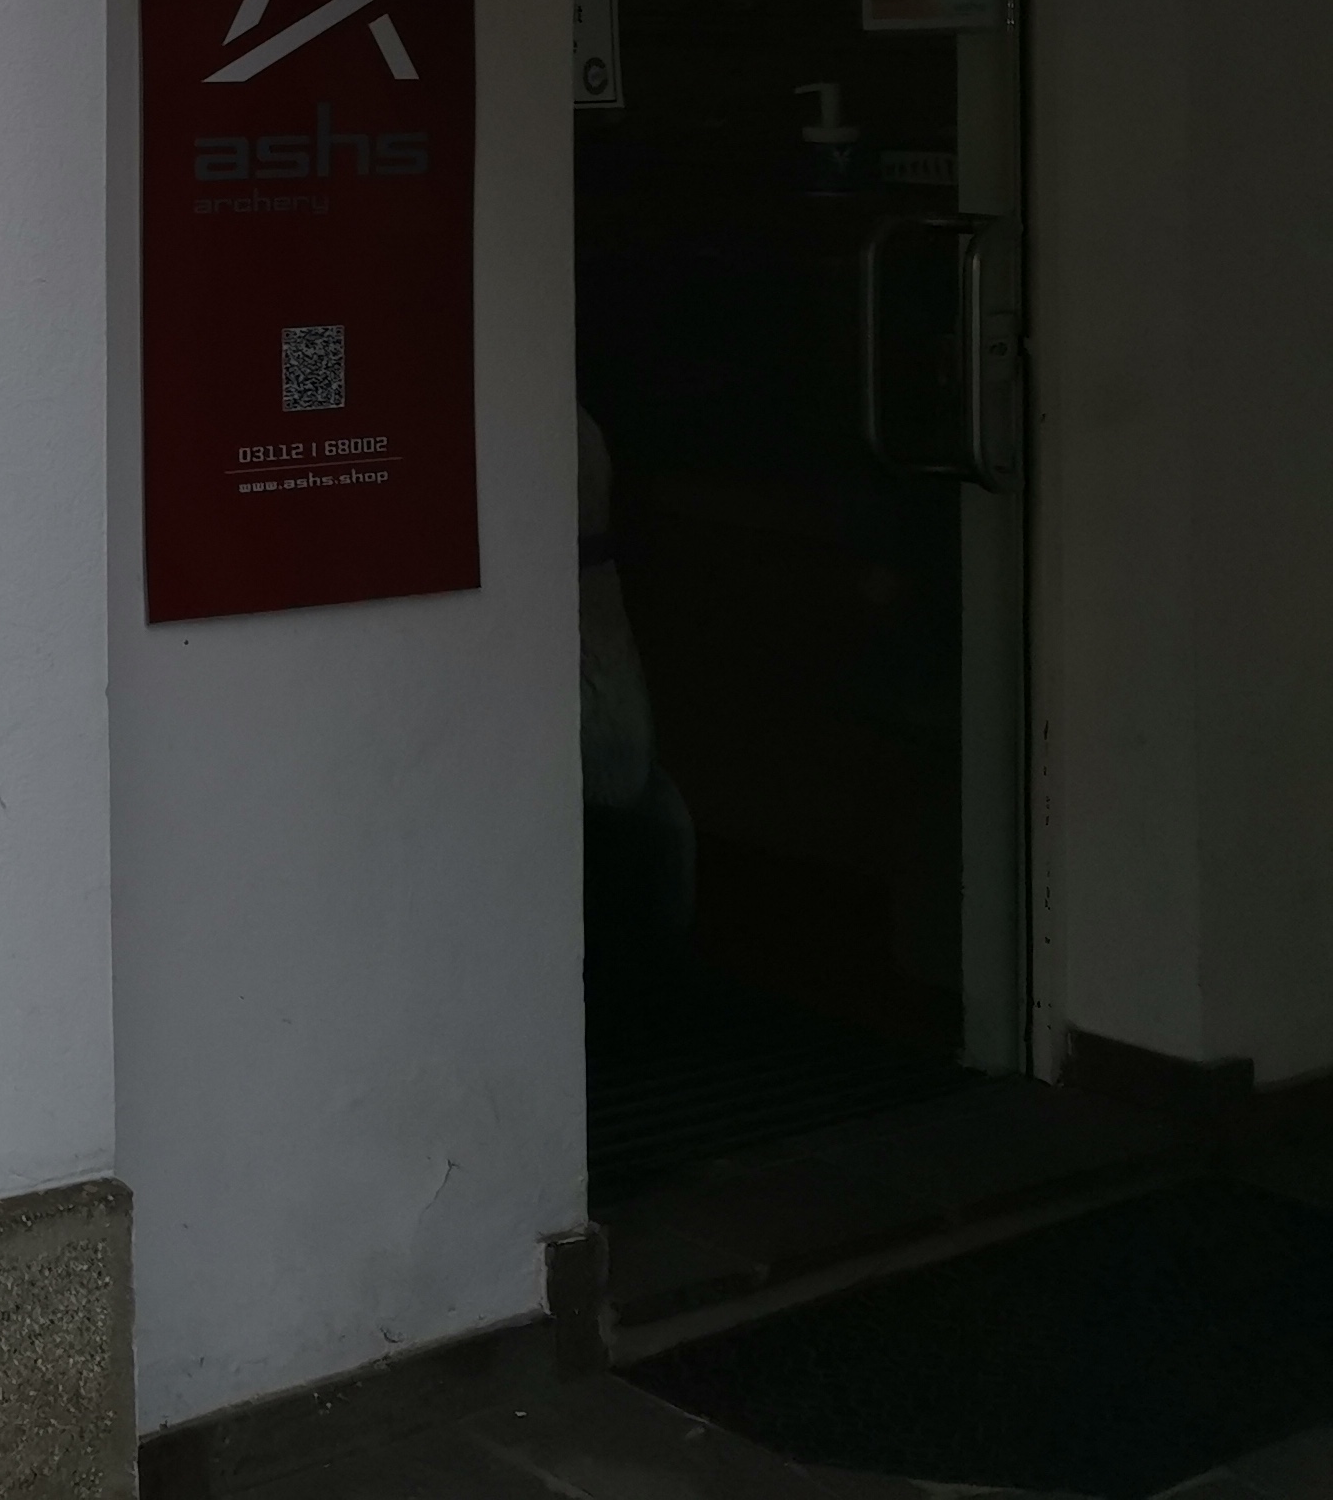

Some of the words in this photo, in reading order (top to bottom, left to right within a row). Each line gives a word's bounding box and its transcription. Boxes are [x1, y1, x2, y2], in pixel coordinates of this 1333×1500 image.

[194, 101, 430, 182] ashs
[193, 187, 330, 215] archery
[238, 442, 304, 463] 03112
[324, 436, 388, 456] 68002
[238, 468, 389, 493] www.ashs.shop
